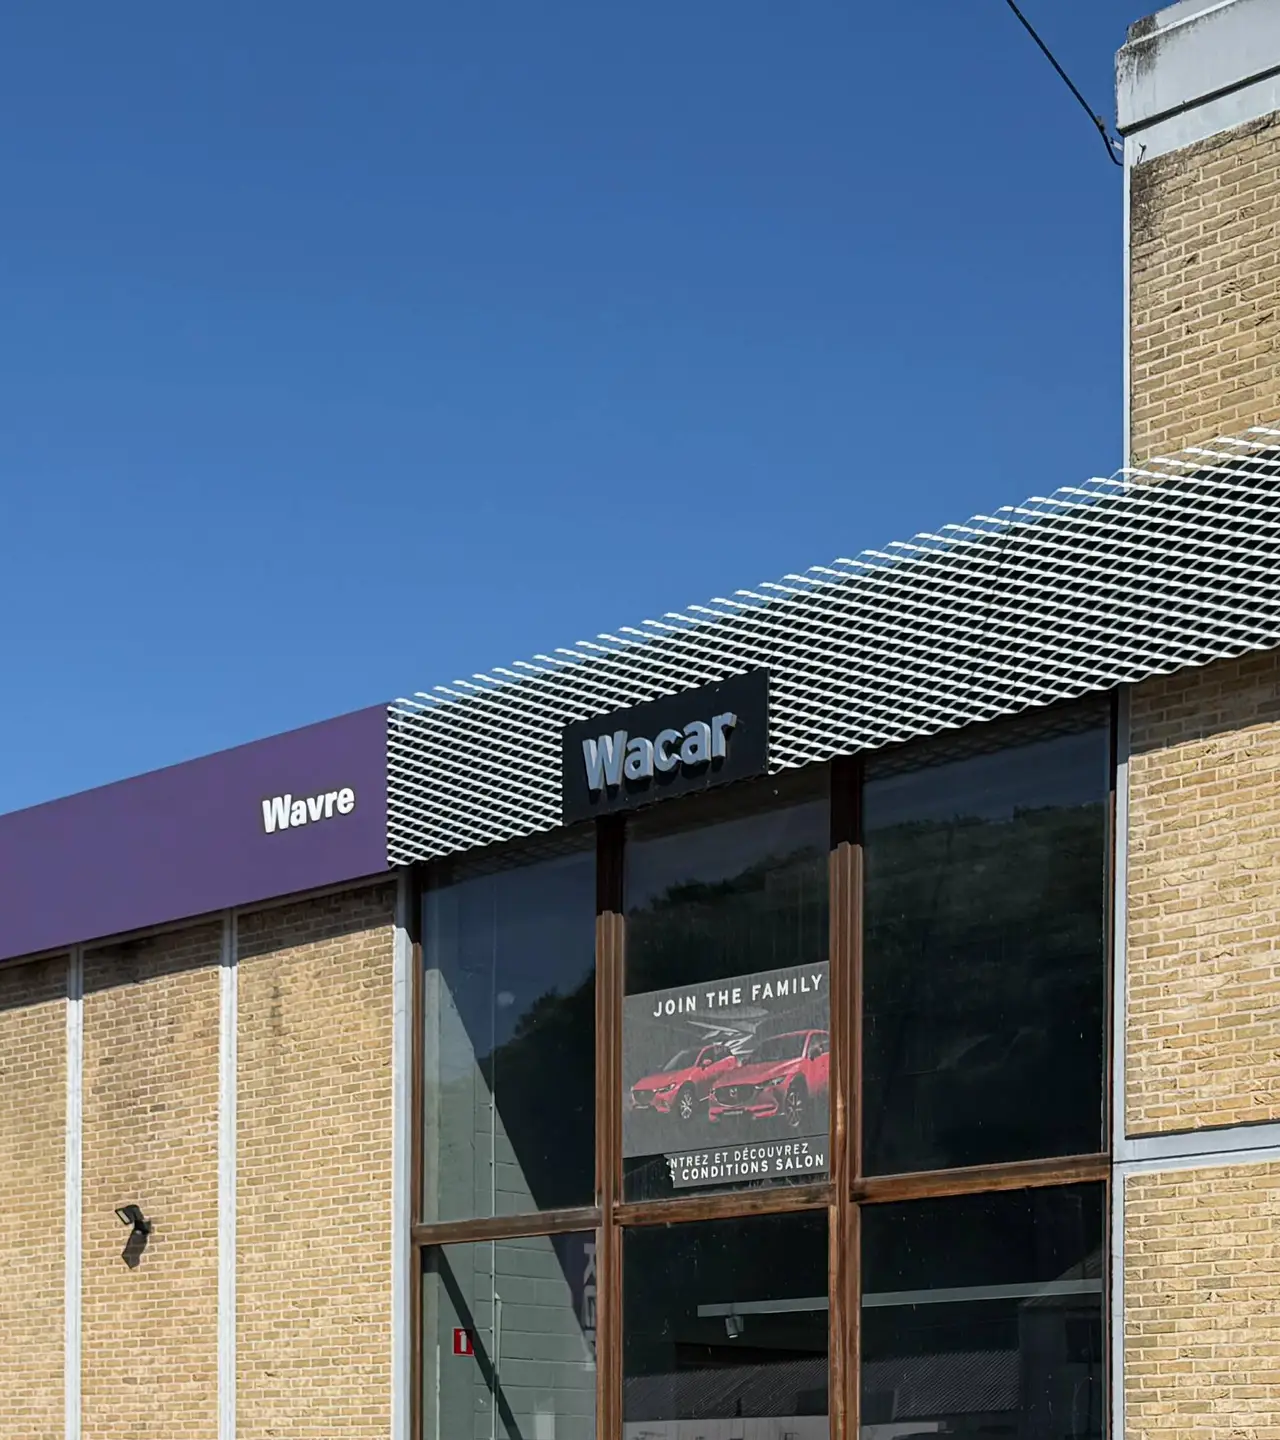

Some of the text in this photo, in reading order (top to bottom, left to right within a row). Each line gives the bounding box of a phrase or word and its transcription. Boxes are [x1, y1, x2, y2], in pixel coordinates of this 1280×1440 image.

[582, 711, 738, 791] Wacar
[262, 787, 355, 834] Wavre
[653, 973, 822, 1017] JOIN THE FAMILY
[665, 1142, 809, 1169] NTREZ ET DÉCOUVREZ
[681, 1160, 769, 1182] CONDITIONS
[775, 1154, 824, 1171] SALON
